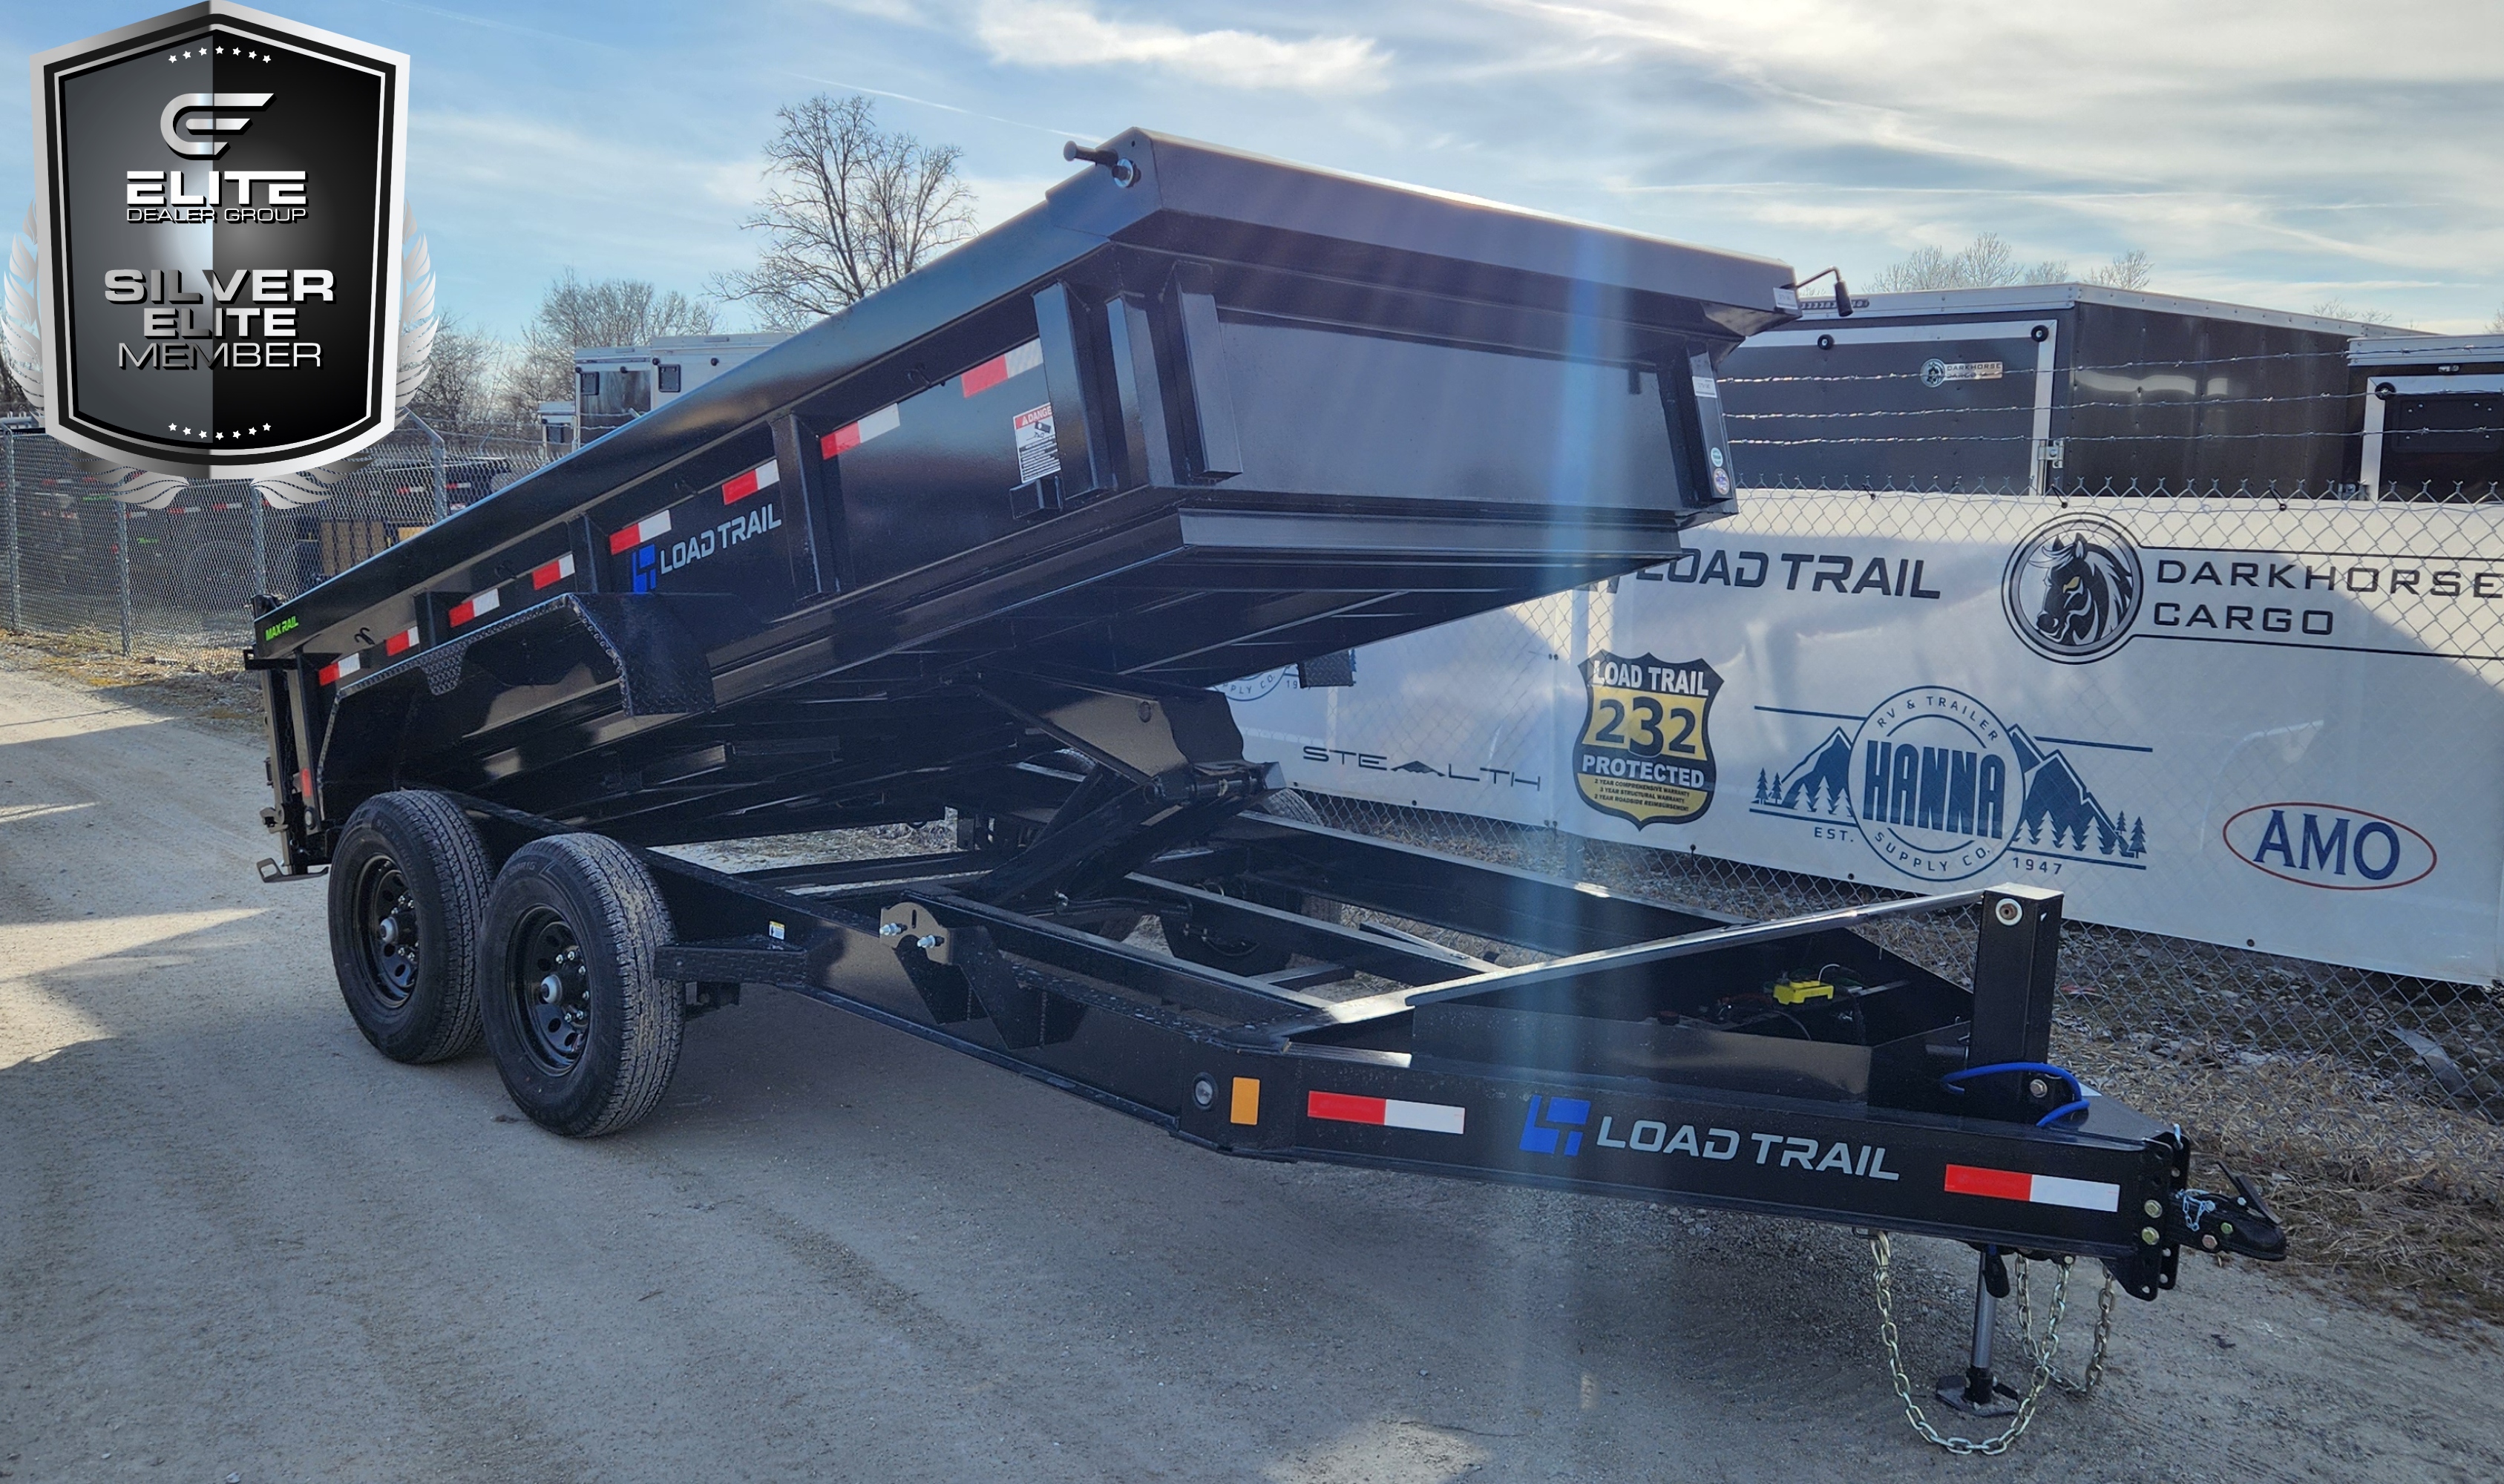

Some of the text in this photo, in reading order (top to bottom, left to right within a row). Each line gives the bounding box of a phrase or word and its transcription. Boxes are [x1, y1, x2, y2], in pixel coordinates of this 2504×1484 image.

[1947, 363, 2002, 371] DARKHORSE
[1027, 405, 1052, 423] DANGE
[661, 503, 781, 575] LOAD TRAIL
[1781, 553, 1941, 599] TRAIL
[2157, 559, 2504, 598] DARKHORSE
[266, 615, 298, 641] MAX RAIL
[2154, 603, 2333, 635] CARGO
[1593, 660, 1709, 696] LOAD TRAIL
[1596, 696, 1696, 757] 232
[1877, 696, 1999, 741] RV & TRAILER
[1303, 745, 1541, 792] STEALTH
[1582, 755, 1704, 789] PROTECTED
[1614, 796, 1642, 805] ROADSIDE
[1644, 800, 1689, 812] REIMBURSEMENT
[1615, 781, 1662, 792] COMPREHENSIVE
[1663, 787, 1690, 797] WARRANTY
[1620, 789, 1656, 799] STRUCTURAL
[1657, 794, 1685, 804] WARRANTY
[1863, 739, 2005, 839] HANNA
[1814, 827, 2062, 875] EST. 1947
[1875, 832, 1990, 872] SUPPLY CO.
[2253, 810, 2401, 881] AMO
[1596, 1116, 1900, 1181] LOAD TRAIL
